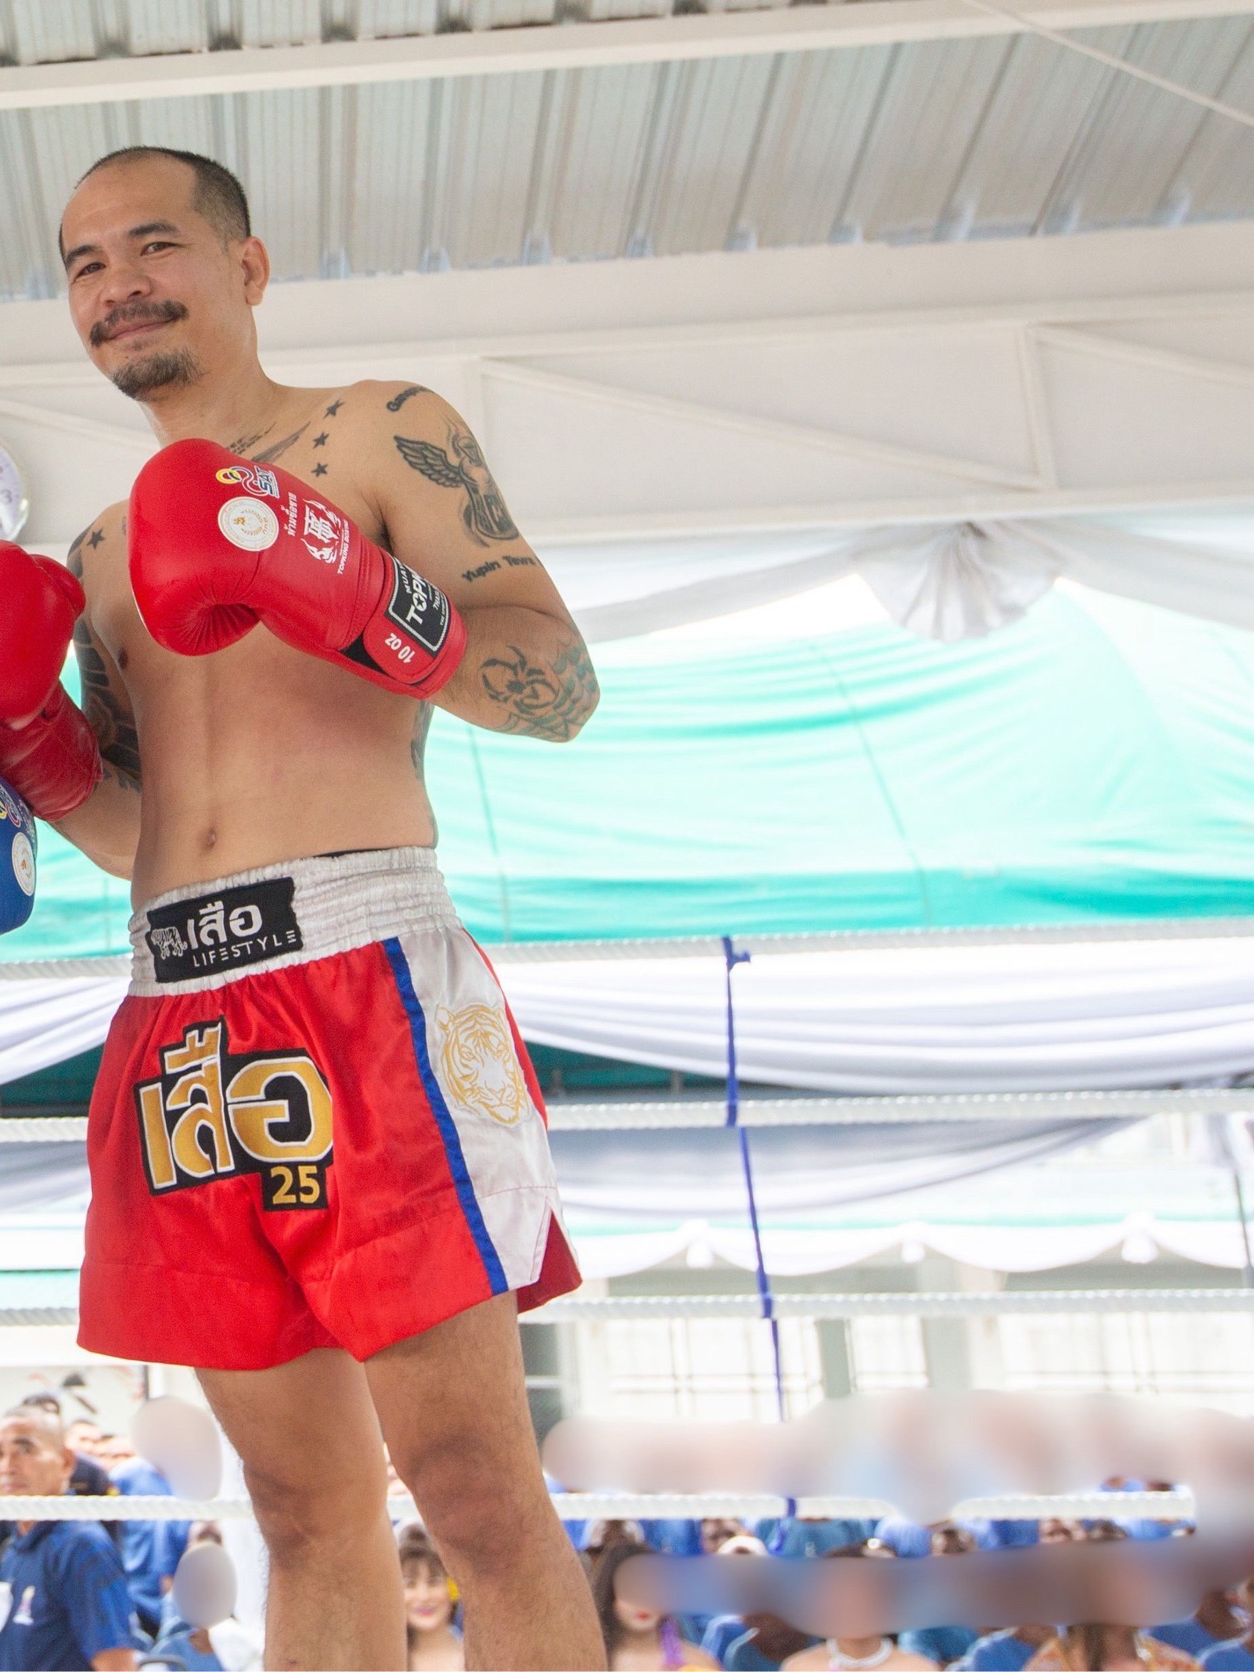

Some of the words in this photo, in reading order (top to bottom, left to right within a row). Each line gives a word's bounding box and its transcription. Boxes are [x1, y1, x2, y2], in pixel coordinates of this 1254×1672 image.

[0, 489, 13, 504] 3
[337, 543, 349, 575] TOPKING
[406, 575, 428, 625] TOPK
[397, 646, 416, 664] 10
[187, 900, 263, 949] เสือ
[192, 929, 297, 968] LIFESTYLE
[139, 1022, 334, 1190] เสือ
[270, 1165, 320, 1205] 25
